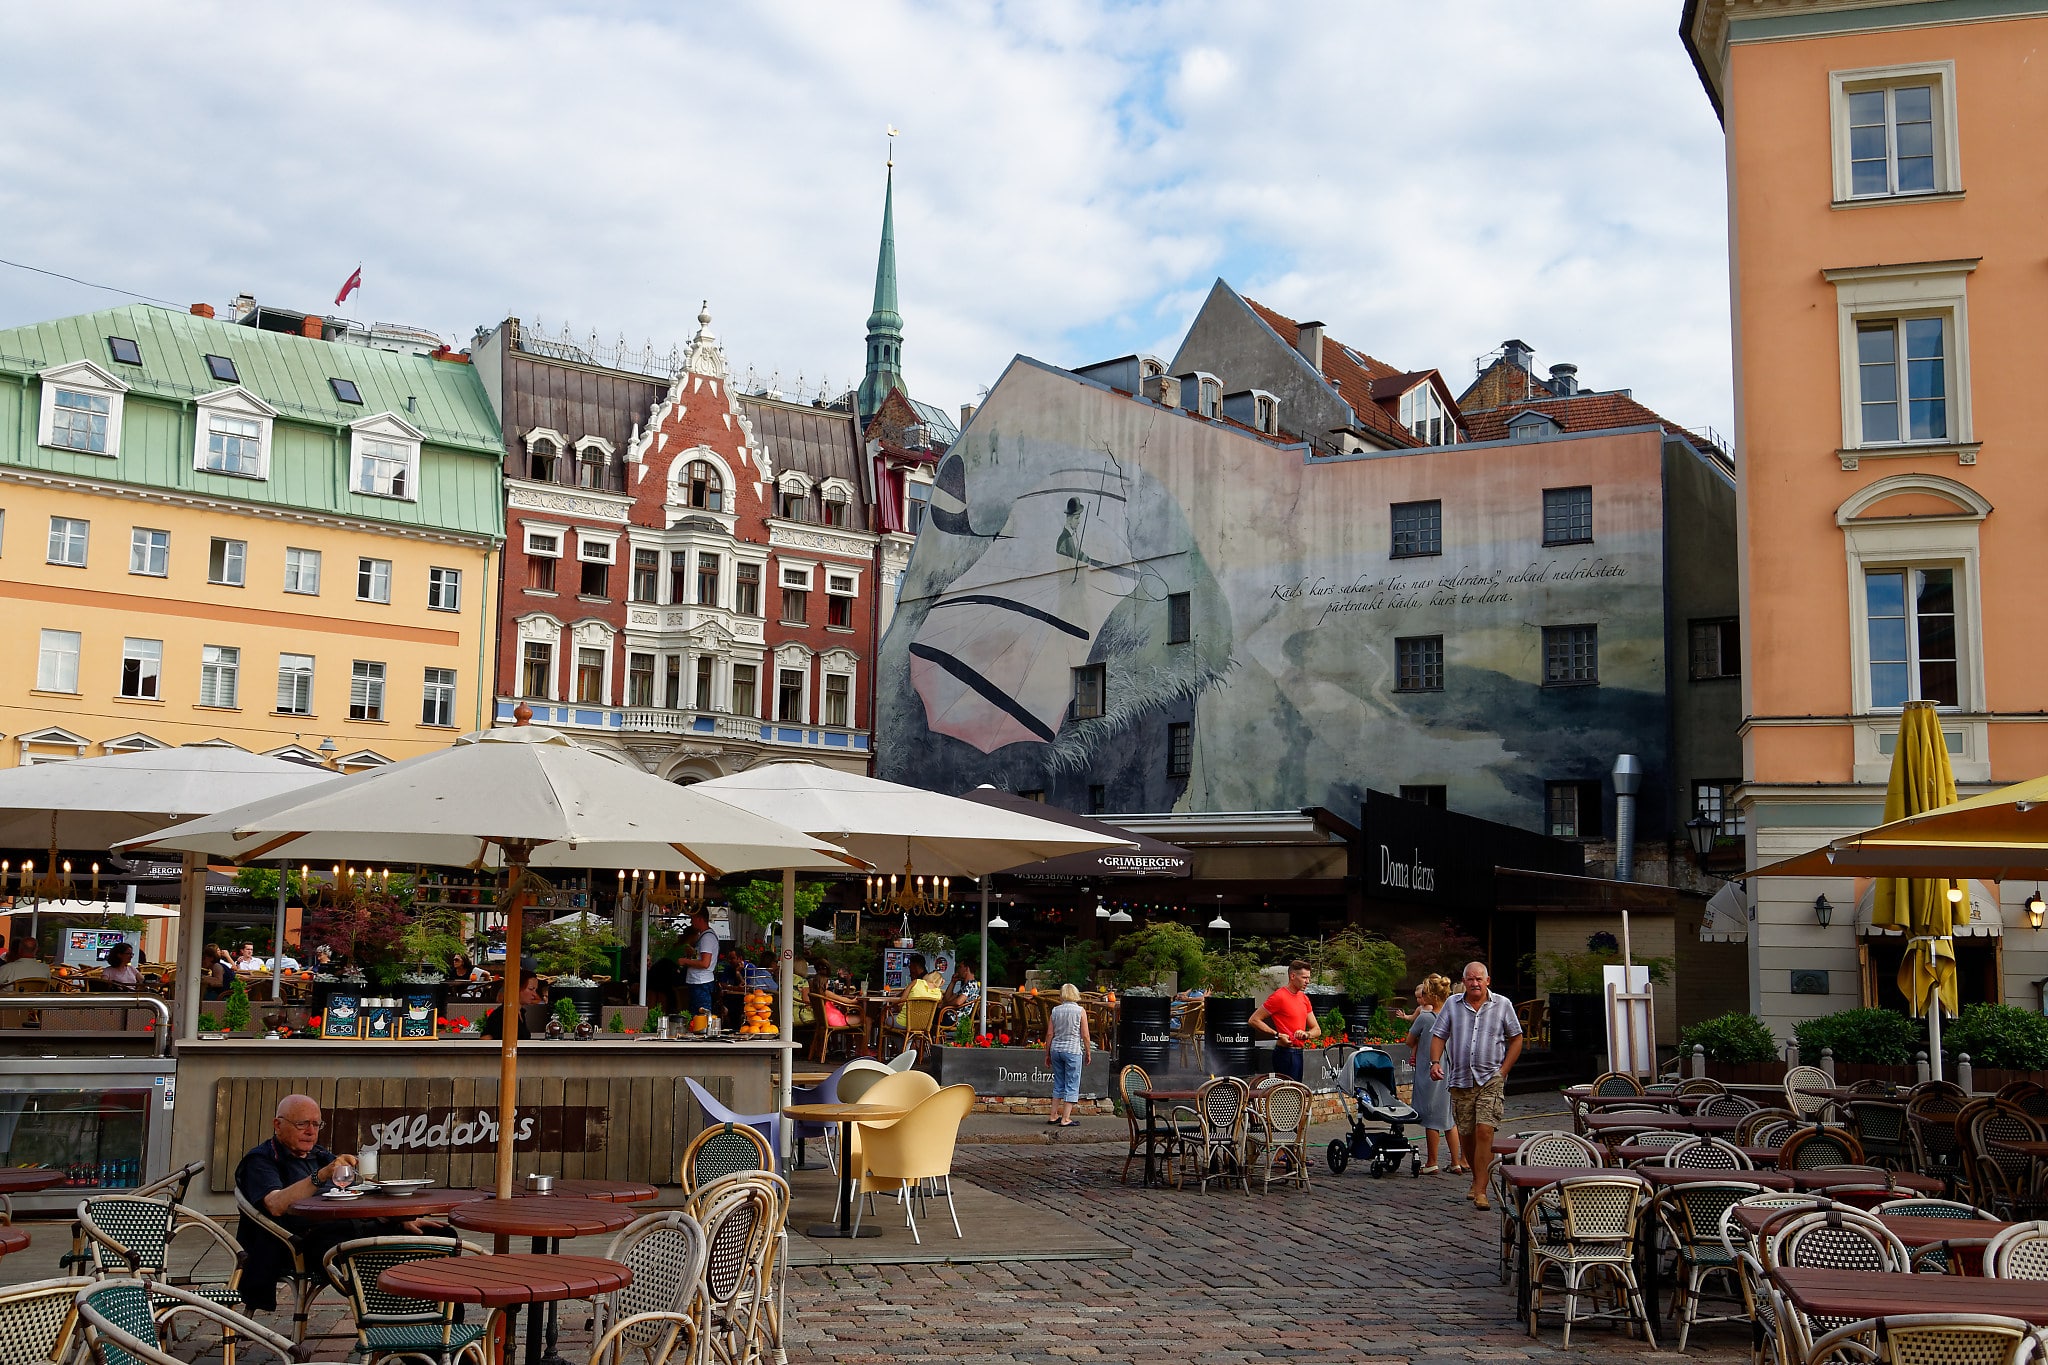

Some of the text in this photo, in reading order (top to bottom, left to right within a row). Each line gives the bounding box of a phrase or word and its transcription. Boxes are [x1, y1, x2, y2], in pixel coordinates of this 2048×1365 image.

[1270, 576, 1308, 601] Kāds
[1309, 576, 1335, 596] kurš
[1337, 573, 1372, 595] saka:
[1411, 579, 1434, 590] nav
[1506, 561, 1557, 583] nekad
[1552, 558, 1628, 580] nedrīkstētu
[1316, 592, 1385, 626] pārtraukt
[1429, 590, 1457, 606] kurš
[1461, 592, 1475, 604] to
[1478, 582, 1513, 604] dara.
[1103, 855, 1179, 867] GRIMBERGEN
[1380, 844, 1435, 892] Doma dārzs
[1140, 1032, 1159, 1042] Doma
[1216, 1033, 1234, 1043] Doma
[999, 1066, 1028, 1082] Doma
